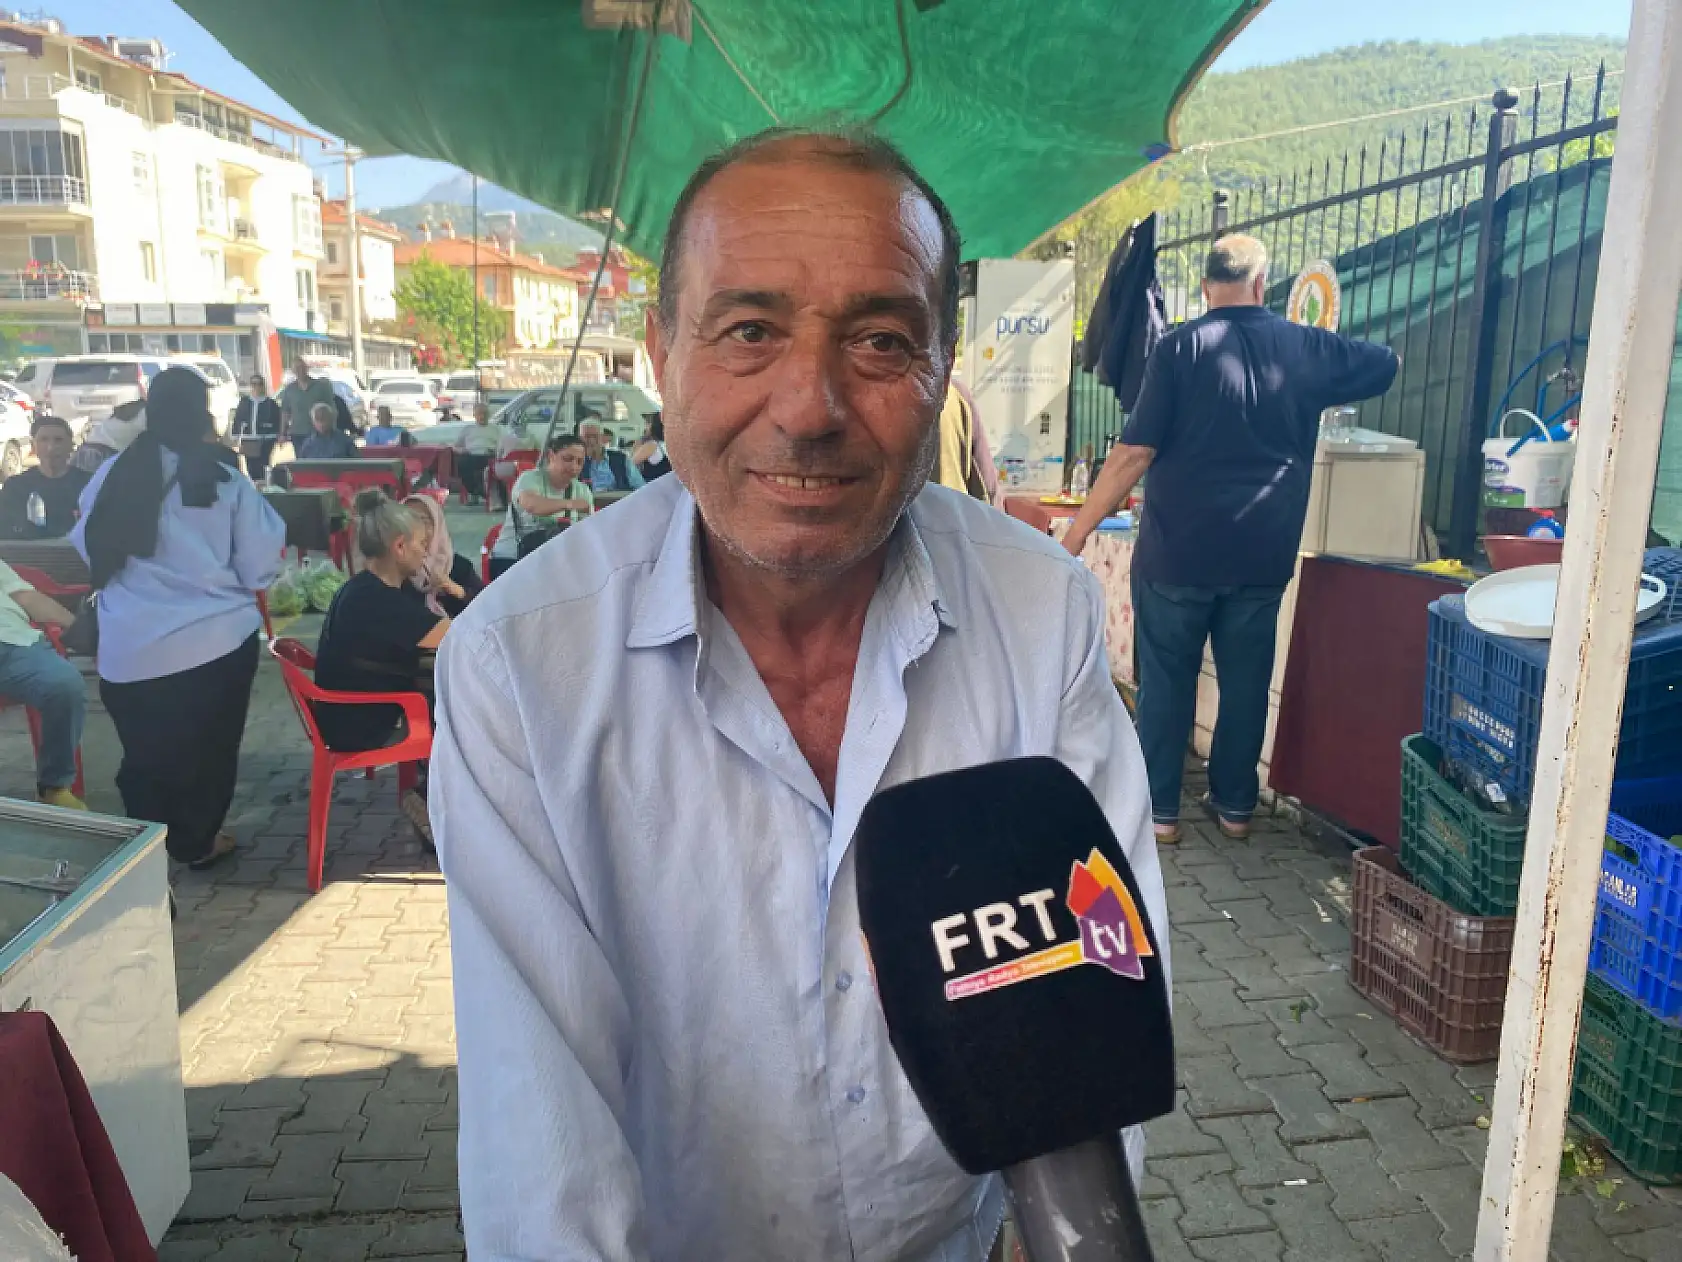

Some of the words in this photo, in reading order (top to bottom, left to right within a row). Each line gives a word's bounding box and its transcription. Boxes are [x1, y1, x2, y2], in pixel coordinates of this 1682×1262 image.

[996, 316, 1050, 340] pursu
[931, 888, 1057, 973] FRT
[1090, 918, 1128, 958] tv
